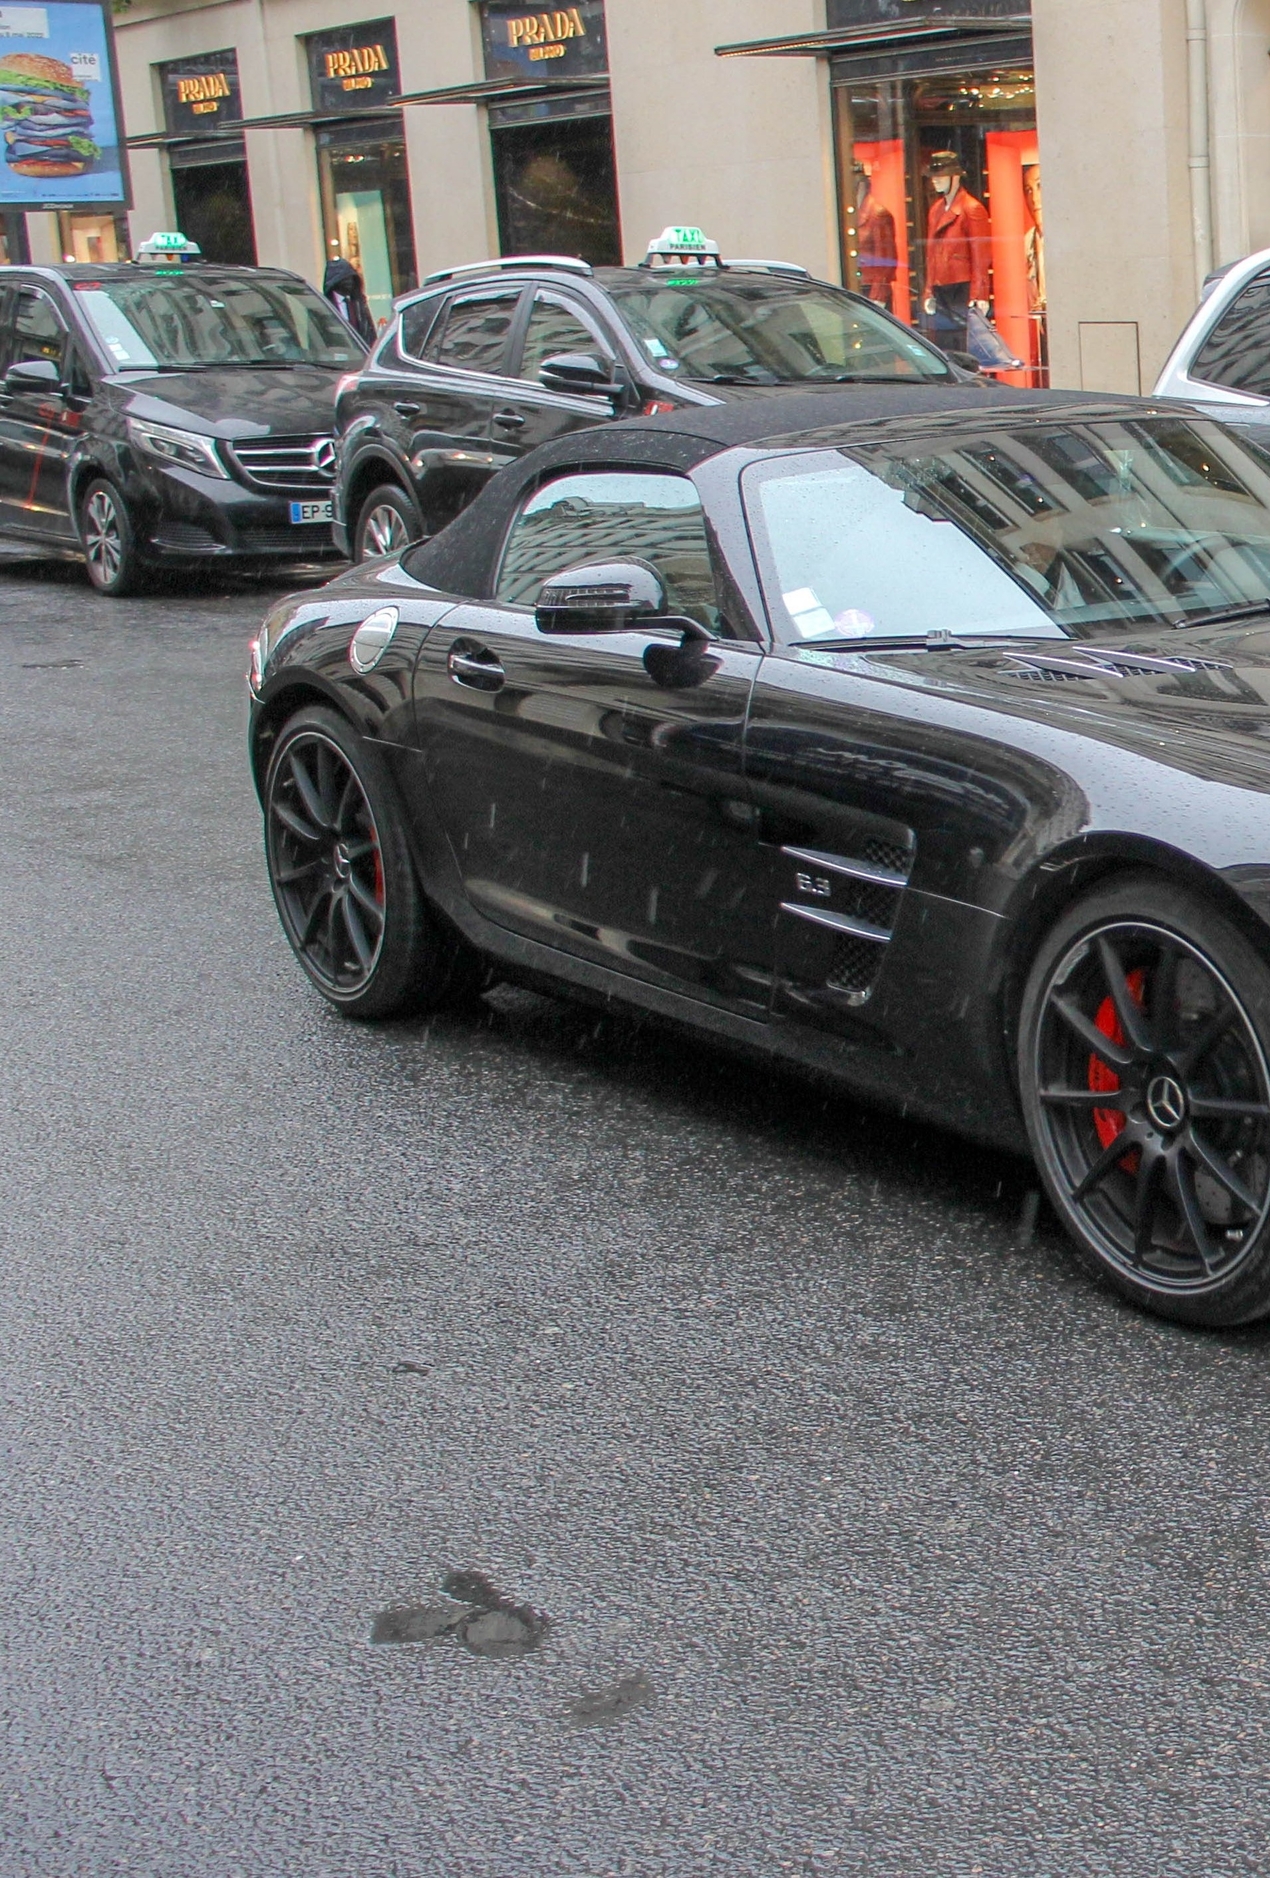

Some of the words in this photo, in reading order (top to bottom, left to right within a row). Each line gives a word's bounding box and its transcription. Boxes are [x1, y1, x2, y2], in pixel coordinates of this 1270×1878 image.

[507, 7, 586, 48] PRADA
[71, 53, 97, 65] cité
[324, 44, 389, 78] PRADA
[178, 72, 231, 103] PRADA
[669, 243, 706, 251] PARISIEN
[674, 228, 704, 244] TAXI
